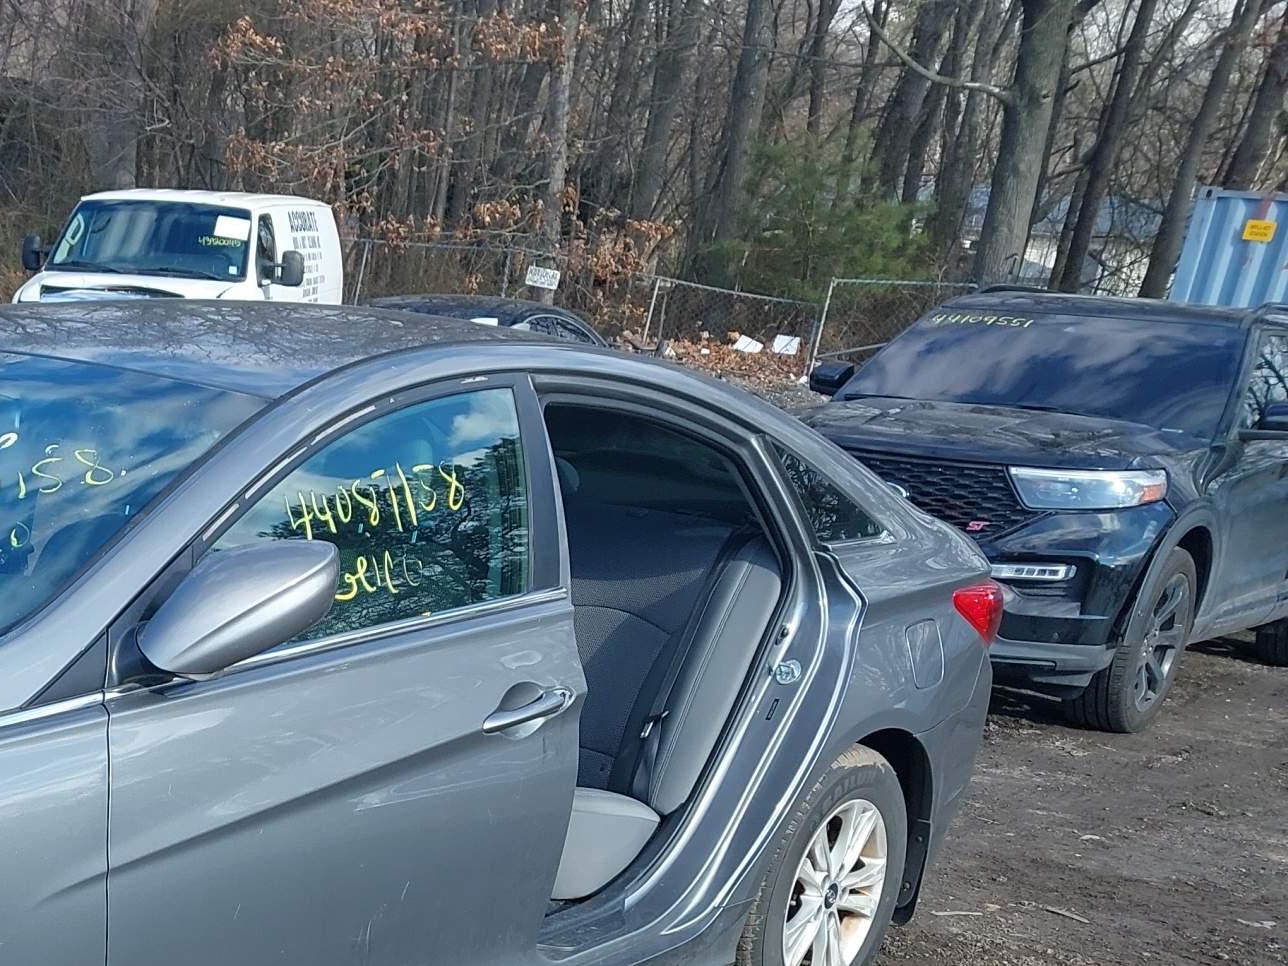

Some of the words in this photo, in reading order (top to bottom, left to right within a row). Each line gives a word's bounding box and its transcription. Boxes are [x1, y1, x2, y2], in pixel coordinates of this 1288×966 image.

[932, 313, 1034, 328] 44109551
[285, 461, 464, 541] 44087158
[966, 521, 991, 531] ST
